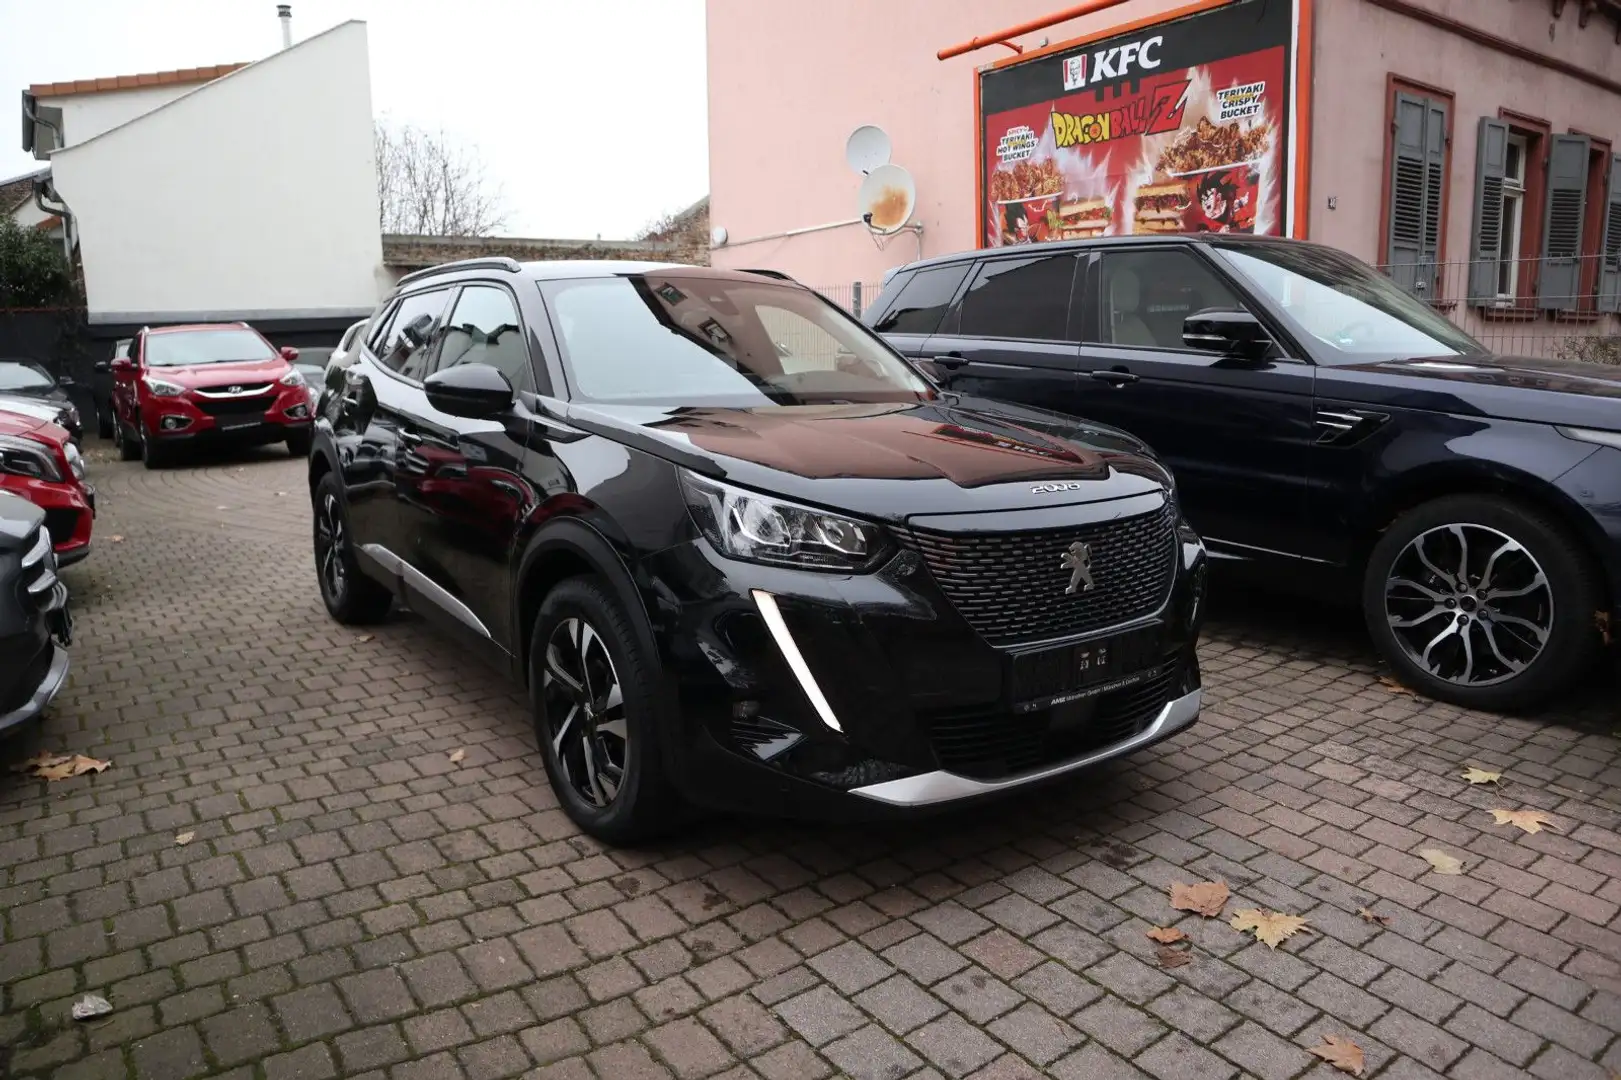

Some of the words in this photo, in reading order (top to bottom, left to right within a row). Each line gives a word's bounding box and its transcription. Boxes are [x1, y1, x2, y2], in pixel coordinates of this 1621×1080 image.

[1090, 35, 1163, 83] KFC
[1218, 83, 1264, 100] TERIYAKI
[1222, 95, 1258, 109] CRISPY
[1051, 110, 1110, 149] DRAGON
[1109, 97, 1146, 139] BALL
[1144, 79, 1193, 136] Z
[1220, 104, 1260, 119] BUCKET
[1002, 132, 1033, 144] TERIYAKI
[1003, 150, 1031, 161] BUCKET
